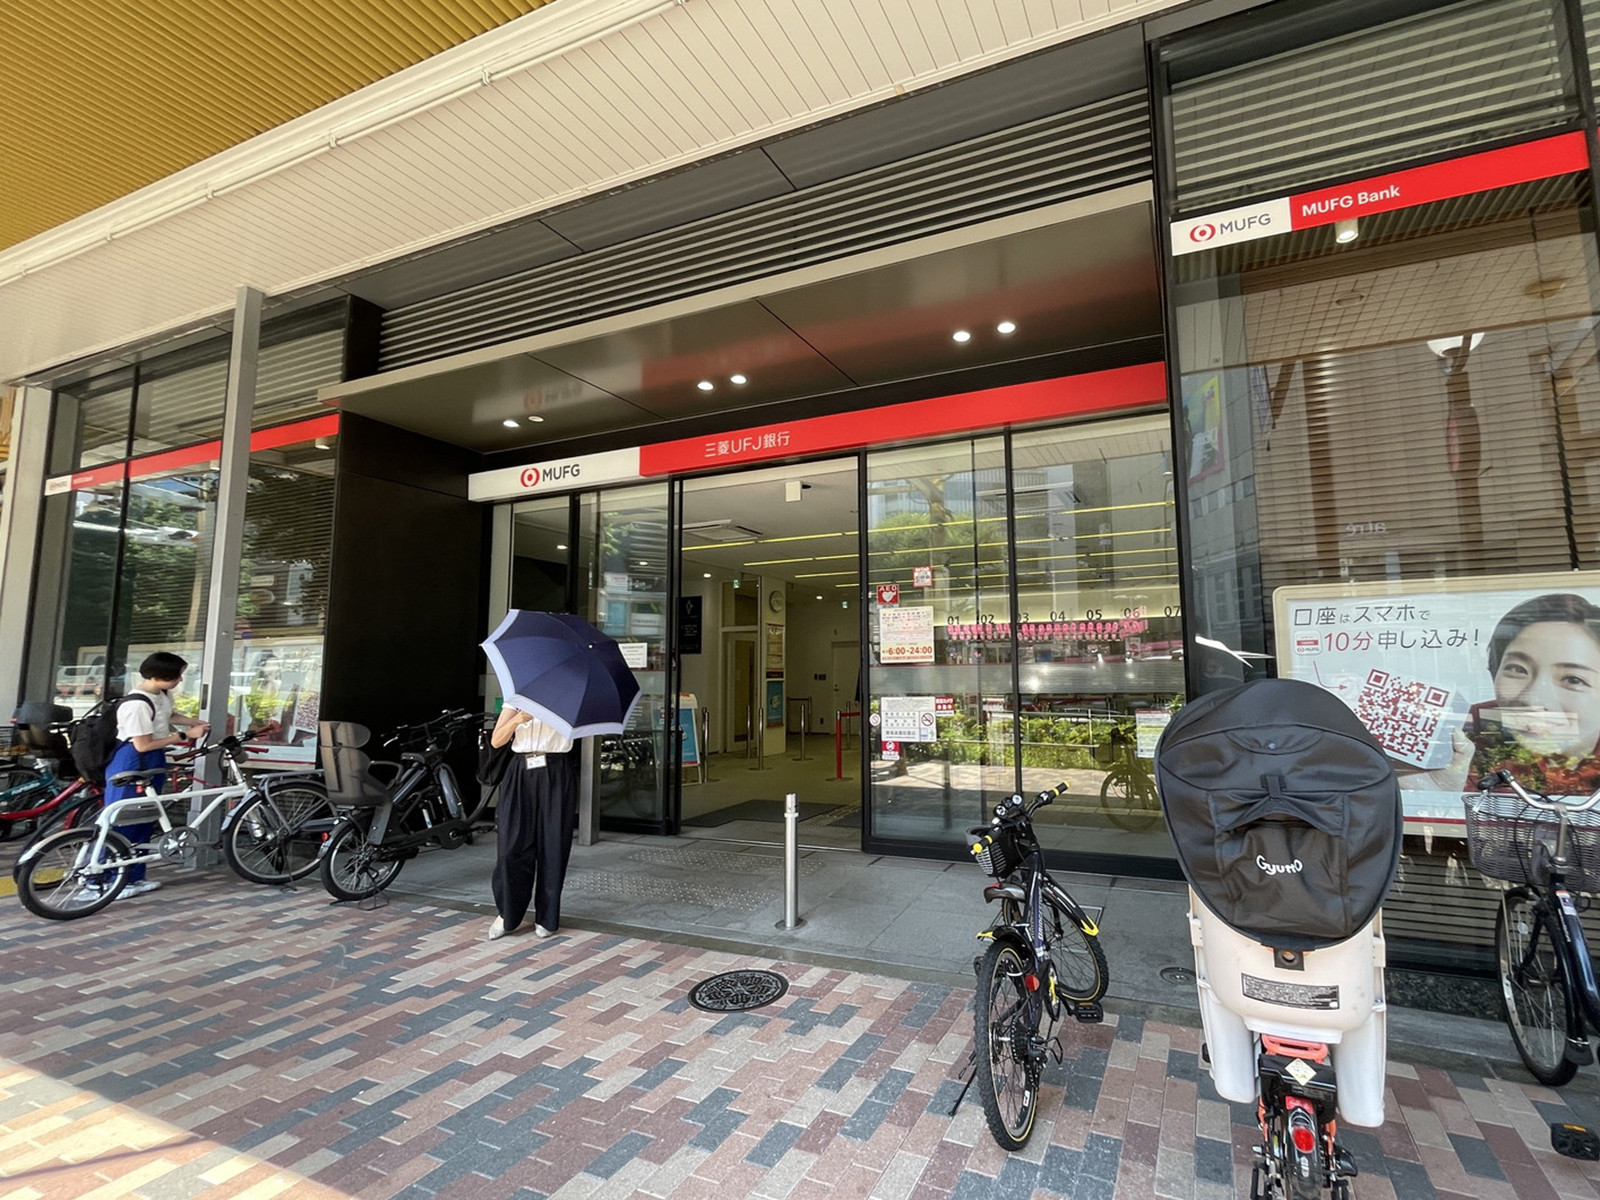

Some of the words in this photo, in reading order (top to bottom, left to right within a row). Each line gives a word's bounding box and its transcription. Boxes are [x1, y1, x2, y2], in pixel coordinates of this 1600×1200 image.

[1302, 196, 1353, 217] MUFG
[1358, 185, 1400, 205] Bank
[1220, 214, 1271, 235] MUFG
[705, 431, 790, 457] 三菱UFJ銀行
[542, 464, 581, 482] MUFG
[947, 616, 960, 625] 01
[980, 614, 994, 624] 02
[1050, 611, 1066, 622] 04
[1086, 609, 1102, 620] 05
[1124, 608, 1140, 618] 06
[1164, 606, 1181, 617] 07
[1294, 603, 1430, 626] 口座はスマホで
